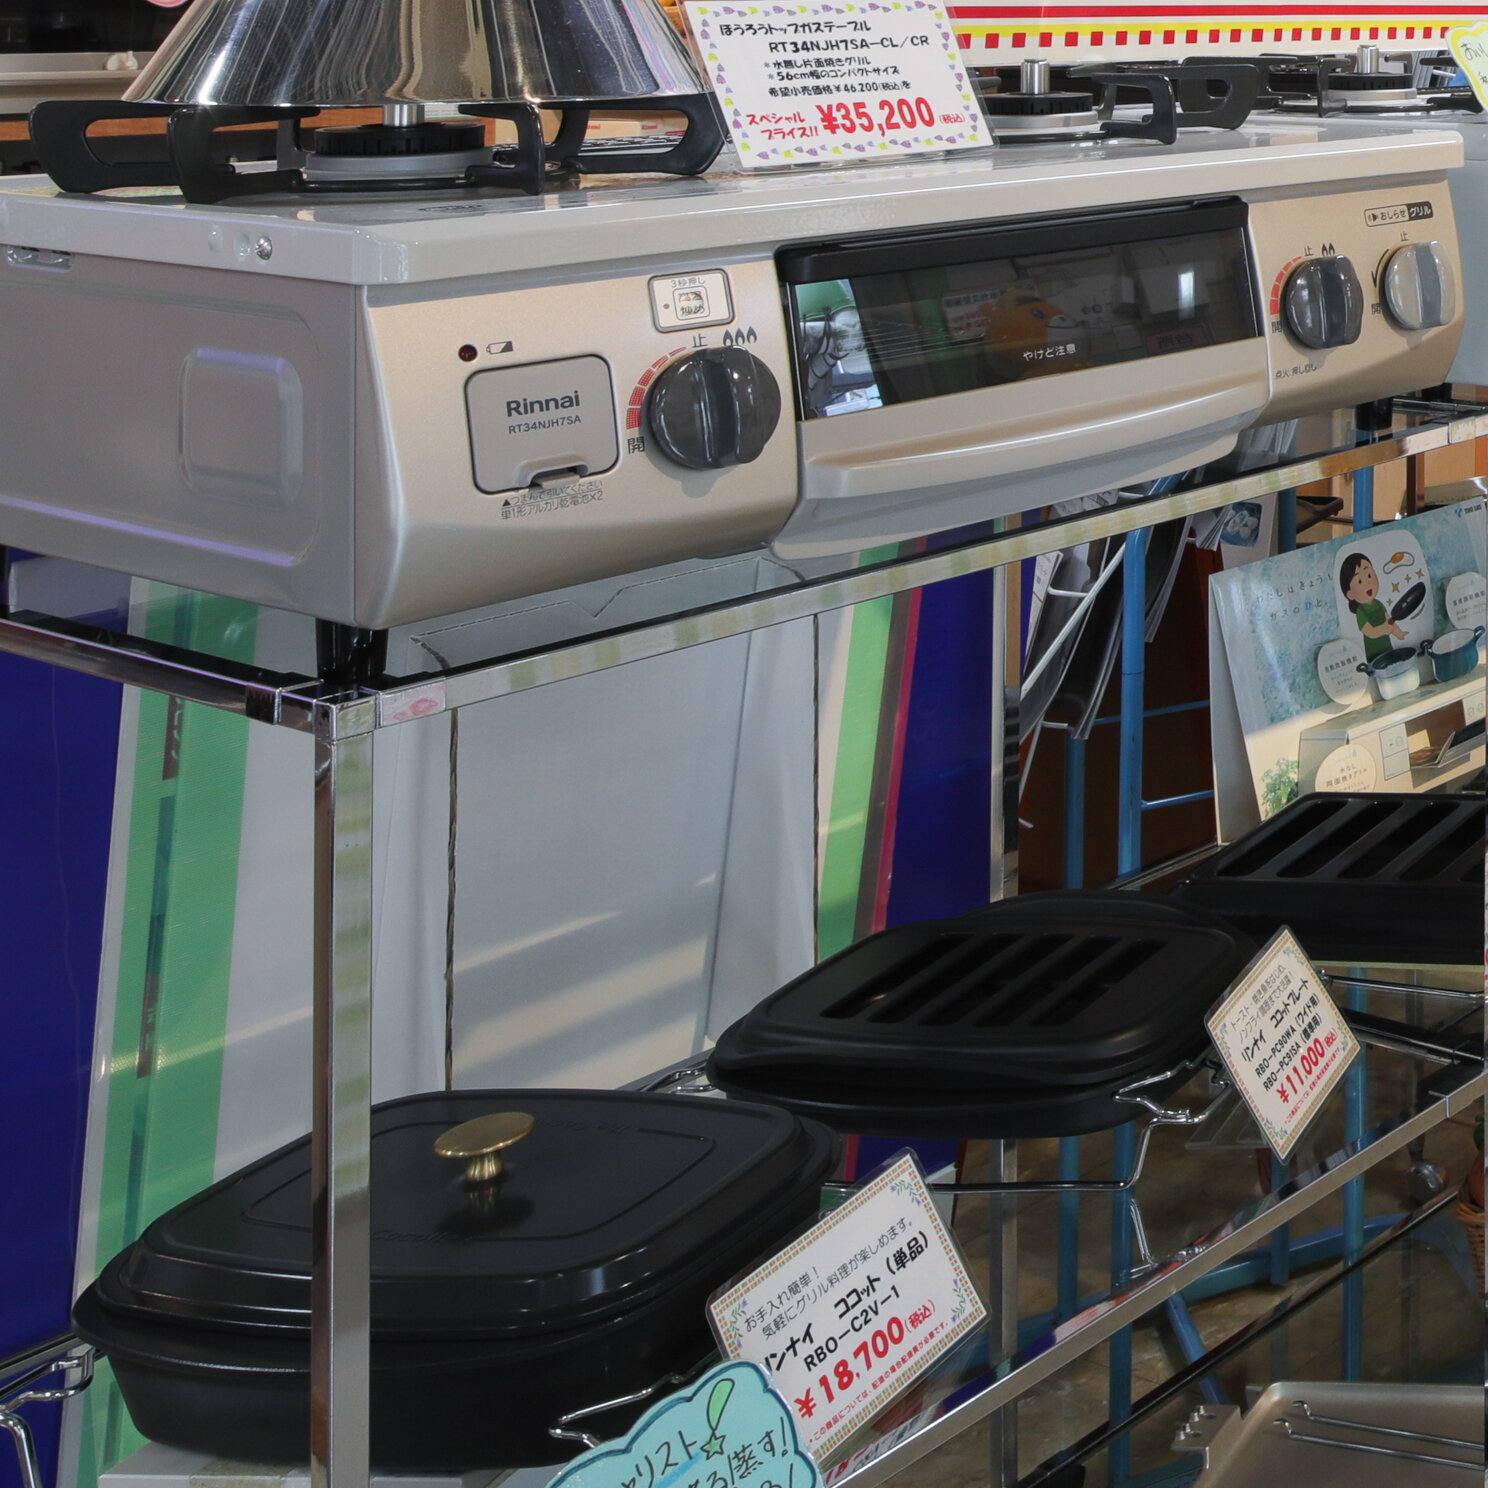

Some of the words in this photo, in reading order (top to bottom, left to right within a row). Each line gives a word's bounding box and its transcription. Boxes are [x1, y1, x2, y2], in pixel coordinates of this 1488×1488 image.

[719, 20, 871, 36] ほうろうトップガステーブル
[746, 112, 805, 126] スペシャル
[817, 97, 935, 138] ¥35,200
[670, 277, 706, 288] 3秒押し
[1023, 343, 1077, 361] やけど注意
[506, 390, 581, 418] Rinnai
[507, 414, 582, 435] RT34NJH7SA
[627, 437, 645, 454] 開
[1276, 1037, 1325, 1104] ¥11,000
[761, 1216, 915, 1339] 気軽にグリル料理が楽しめます。
[835, 1274, 881, 1318] ココット
[886, 1229, 928, 1276] (単品)
[743, 1264, 820, 1335] お手入れ簡単!
[803, 1282, 902, 1372] RBO-C2V-1
[796, 1315, 907, 1421] ¥18,700
[904, 1298, 935, 1335] (税込)
